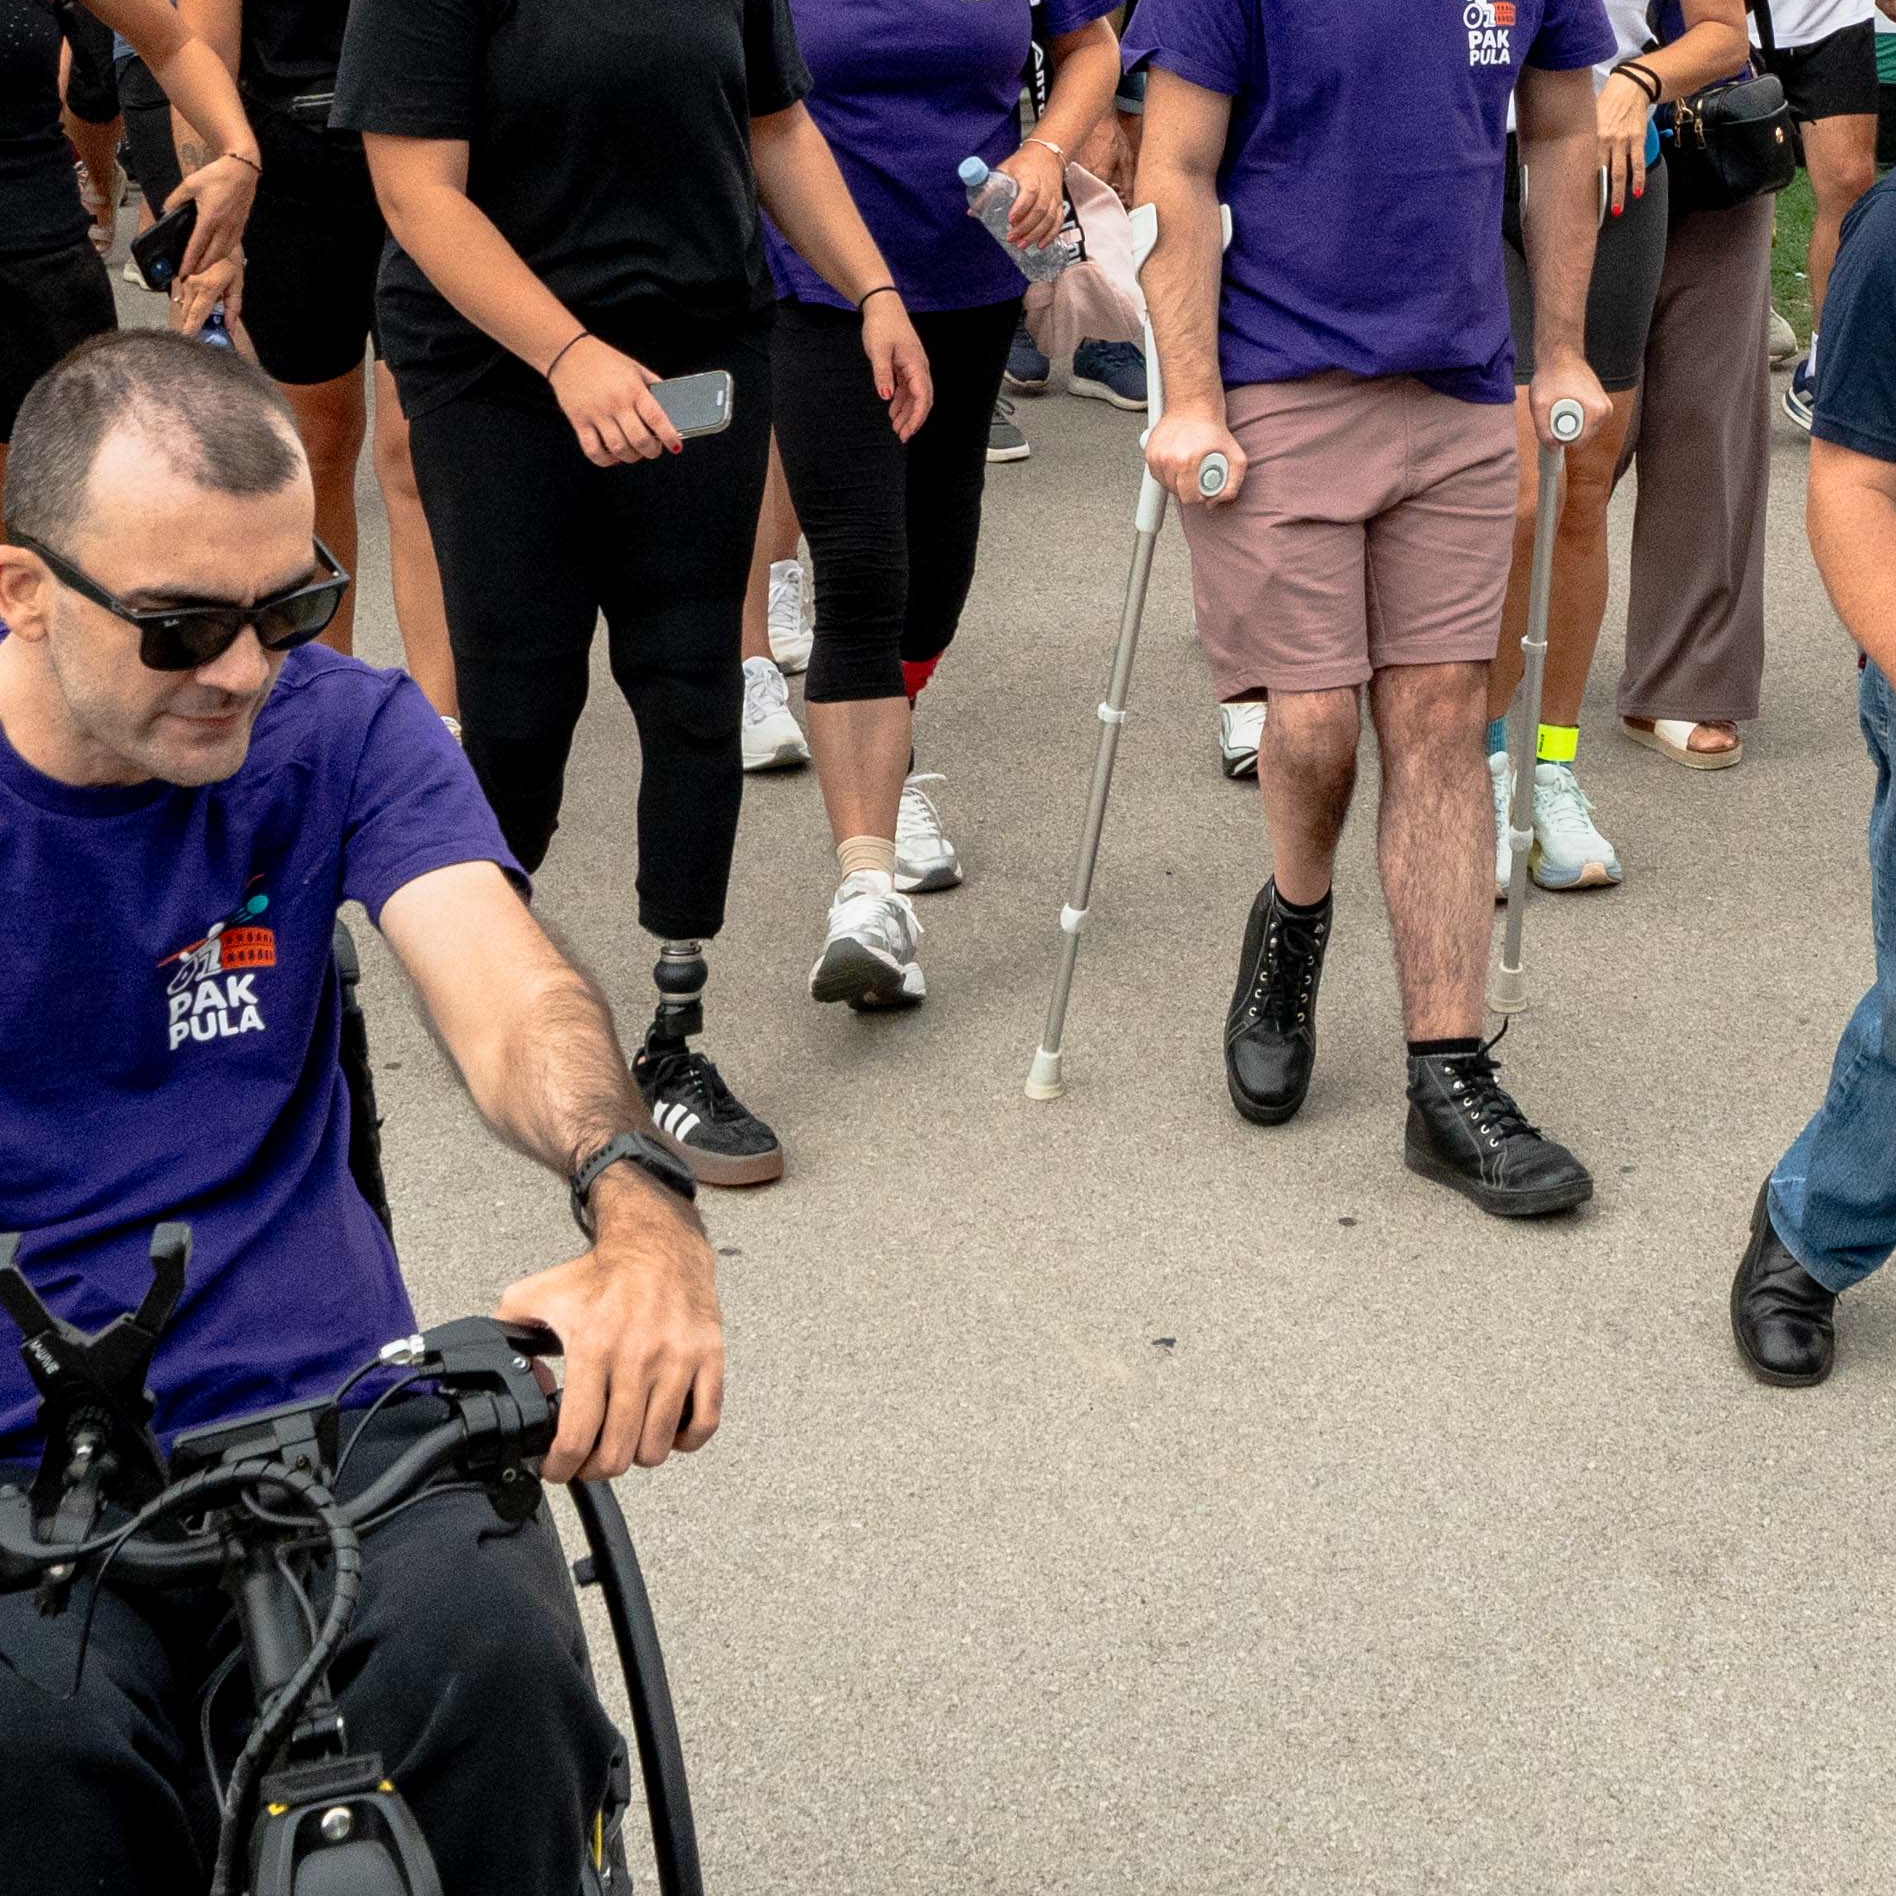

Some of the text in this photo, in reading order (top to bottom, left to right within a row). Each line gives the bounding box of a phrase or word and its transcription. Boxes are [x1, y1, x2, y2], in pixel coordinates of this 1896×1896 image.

[1468, 29, 1510, 50] PAK
[1469, 48, 1511, 67] PULA
[169, 973, 259, 1025] PAK
[169, 1004, 266, 1051] PULA
